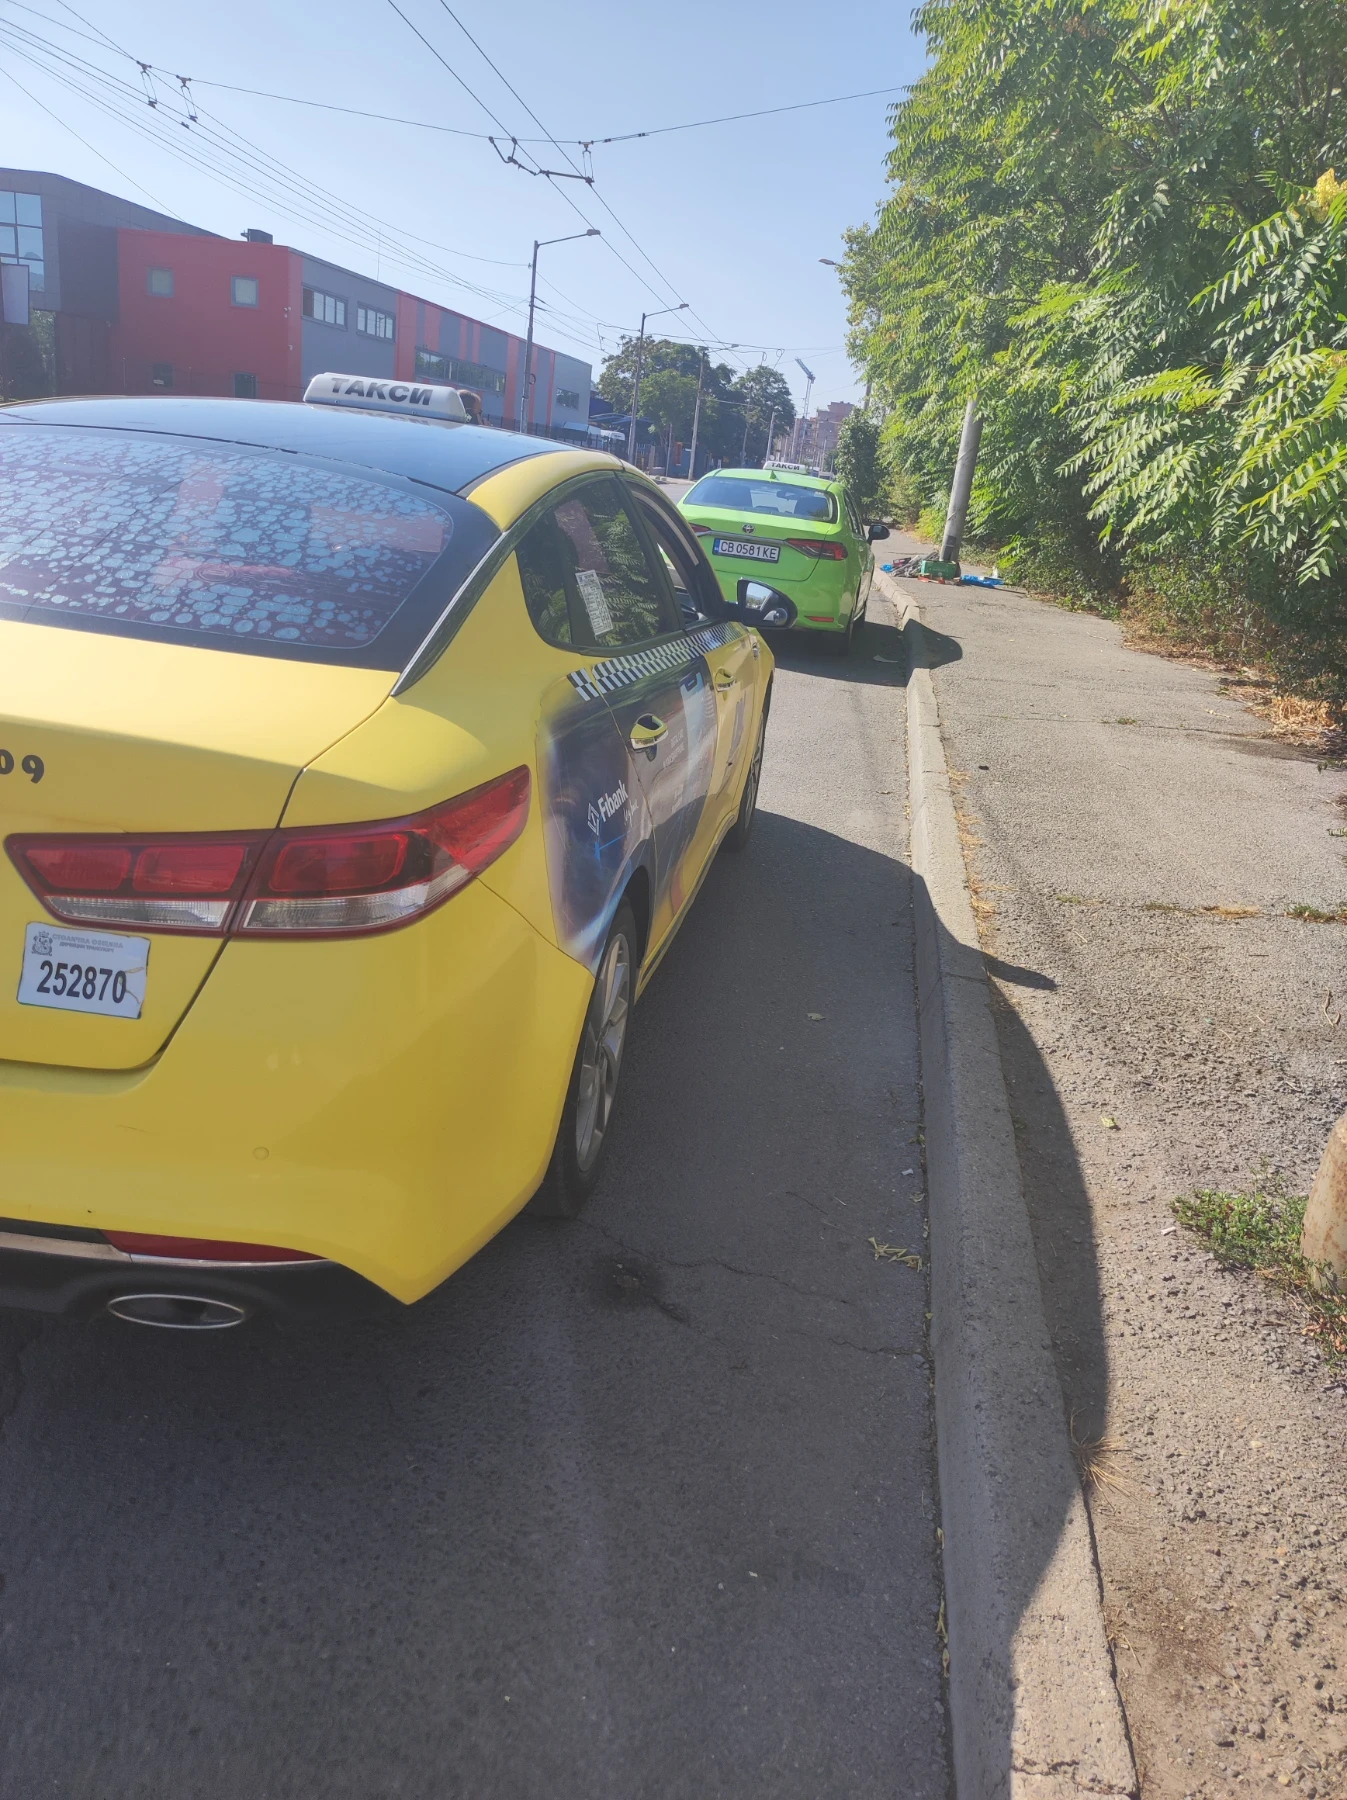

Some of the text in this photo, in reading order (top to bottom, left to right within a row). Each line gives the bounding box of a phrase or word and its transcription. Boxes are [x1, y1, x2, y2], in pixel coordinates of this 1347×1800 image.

[331, 377, 433, 406] ТАКСИ
[771, 462, 800, 471] ТАКСИ
[720, 541, 777, 560] CB 0581 KE
[598, 780, 629, 822] Fibank
[36, 960, 127, 1004] 252870
